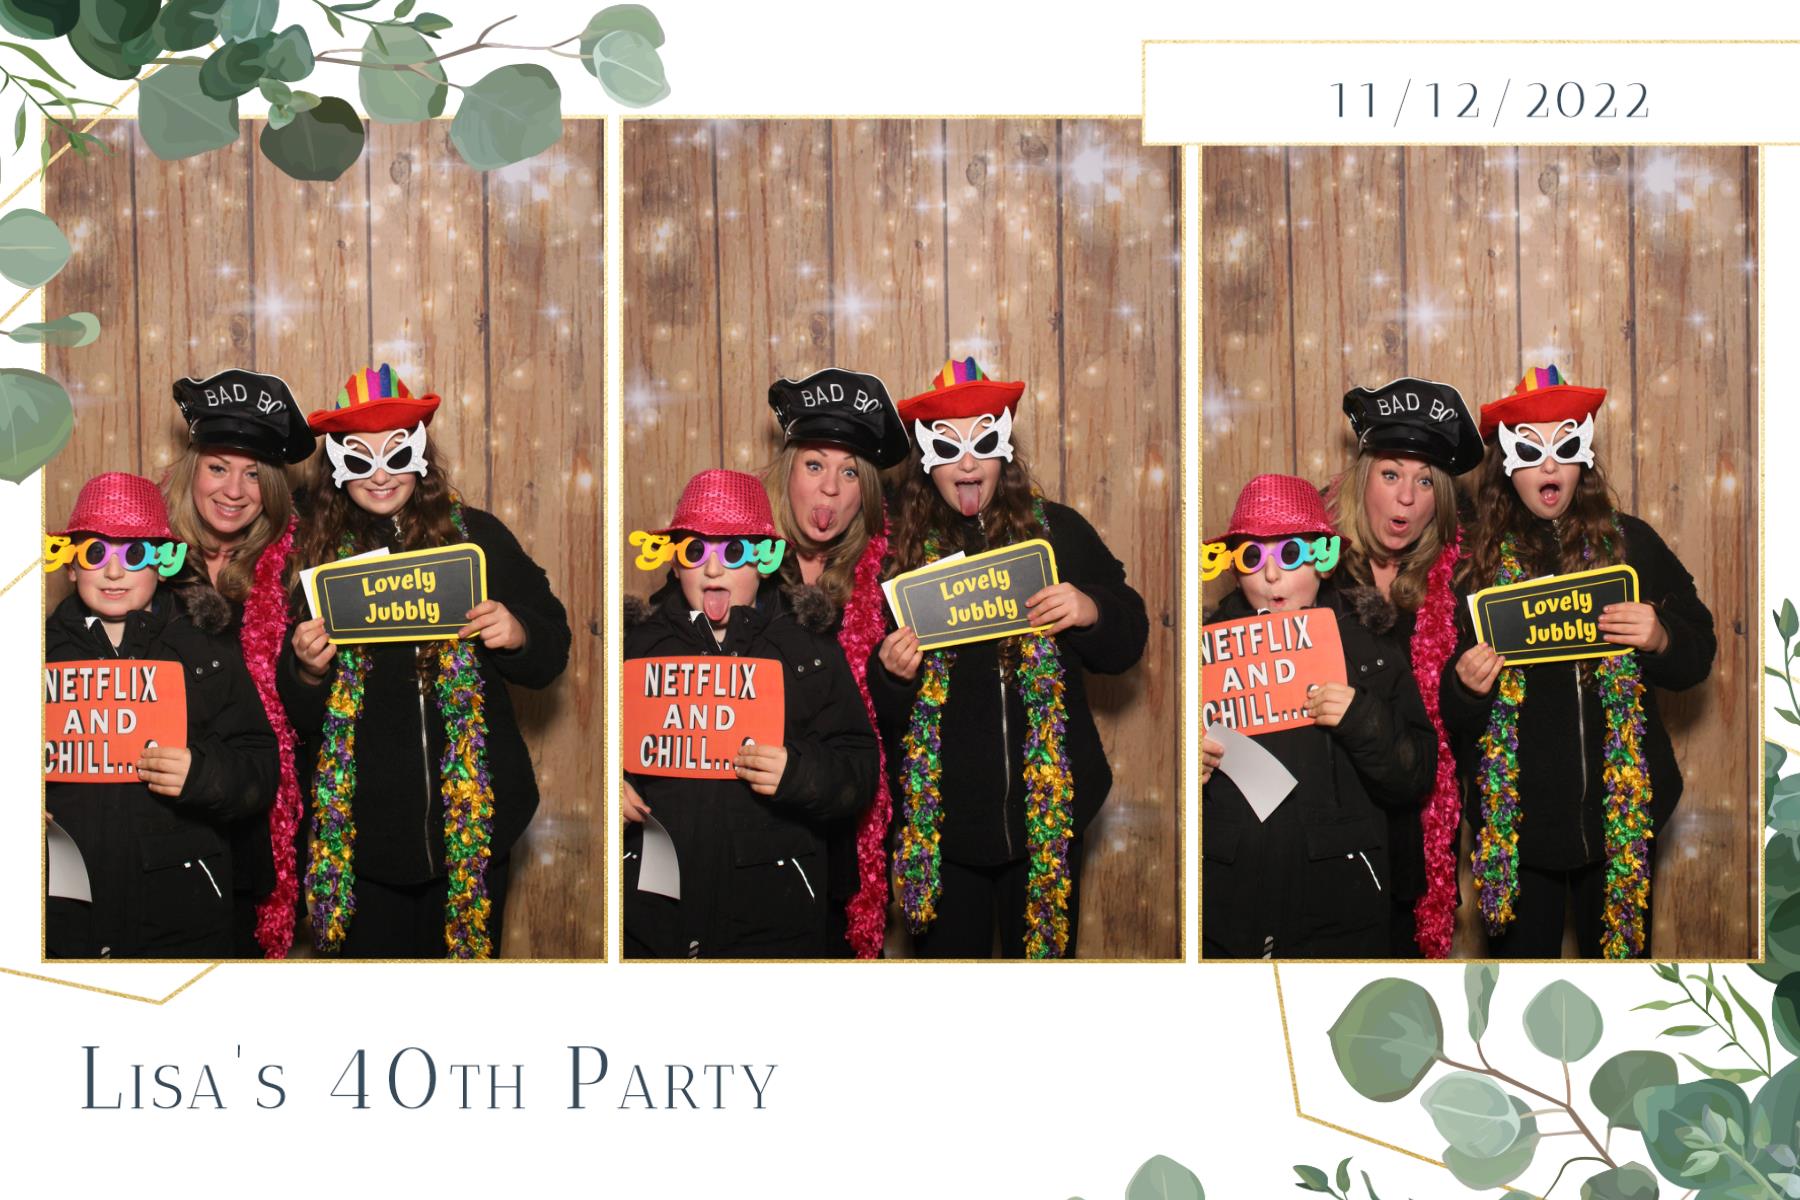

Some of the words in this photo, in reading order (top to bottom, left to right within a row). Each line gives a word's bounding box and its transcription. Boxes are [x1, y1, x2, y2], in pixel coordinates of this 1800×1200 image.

[204, 383, 248, 407] BAD
[257, 390, 287, 414] BO
[801, 383, 844, 407] BAD
[853, 389, 882, 413] BO
[1377, 392, 1420, 416] BAD
[1429, 398, 1458, 422] BO
[361, 567, 437, 597] Lovely
[939, 567, 1011, 600] Lovely
[365, 597, 440, 624] Jubbly
[947, 596, 1018, 626] Jubbly
[1521, 589, 1593, 620] Lovely
[1525, 617, 1597, 645] Jubbly
[45, 665, 158, 703] NETFLIX
[644, 663, 757, 699] NETFLIX
[1222, 658, 1296, 693] AND
[63, 708, 137, 735] AND
[662, 703, 736, 731] AND
